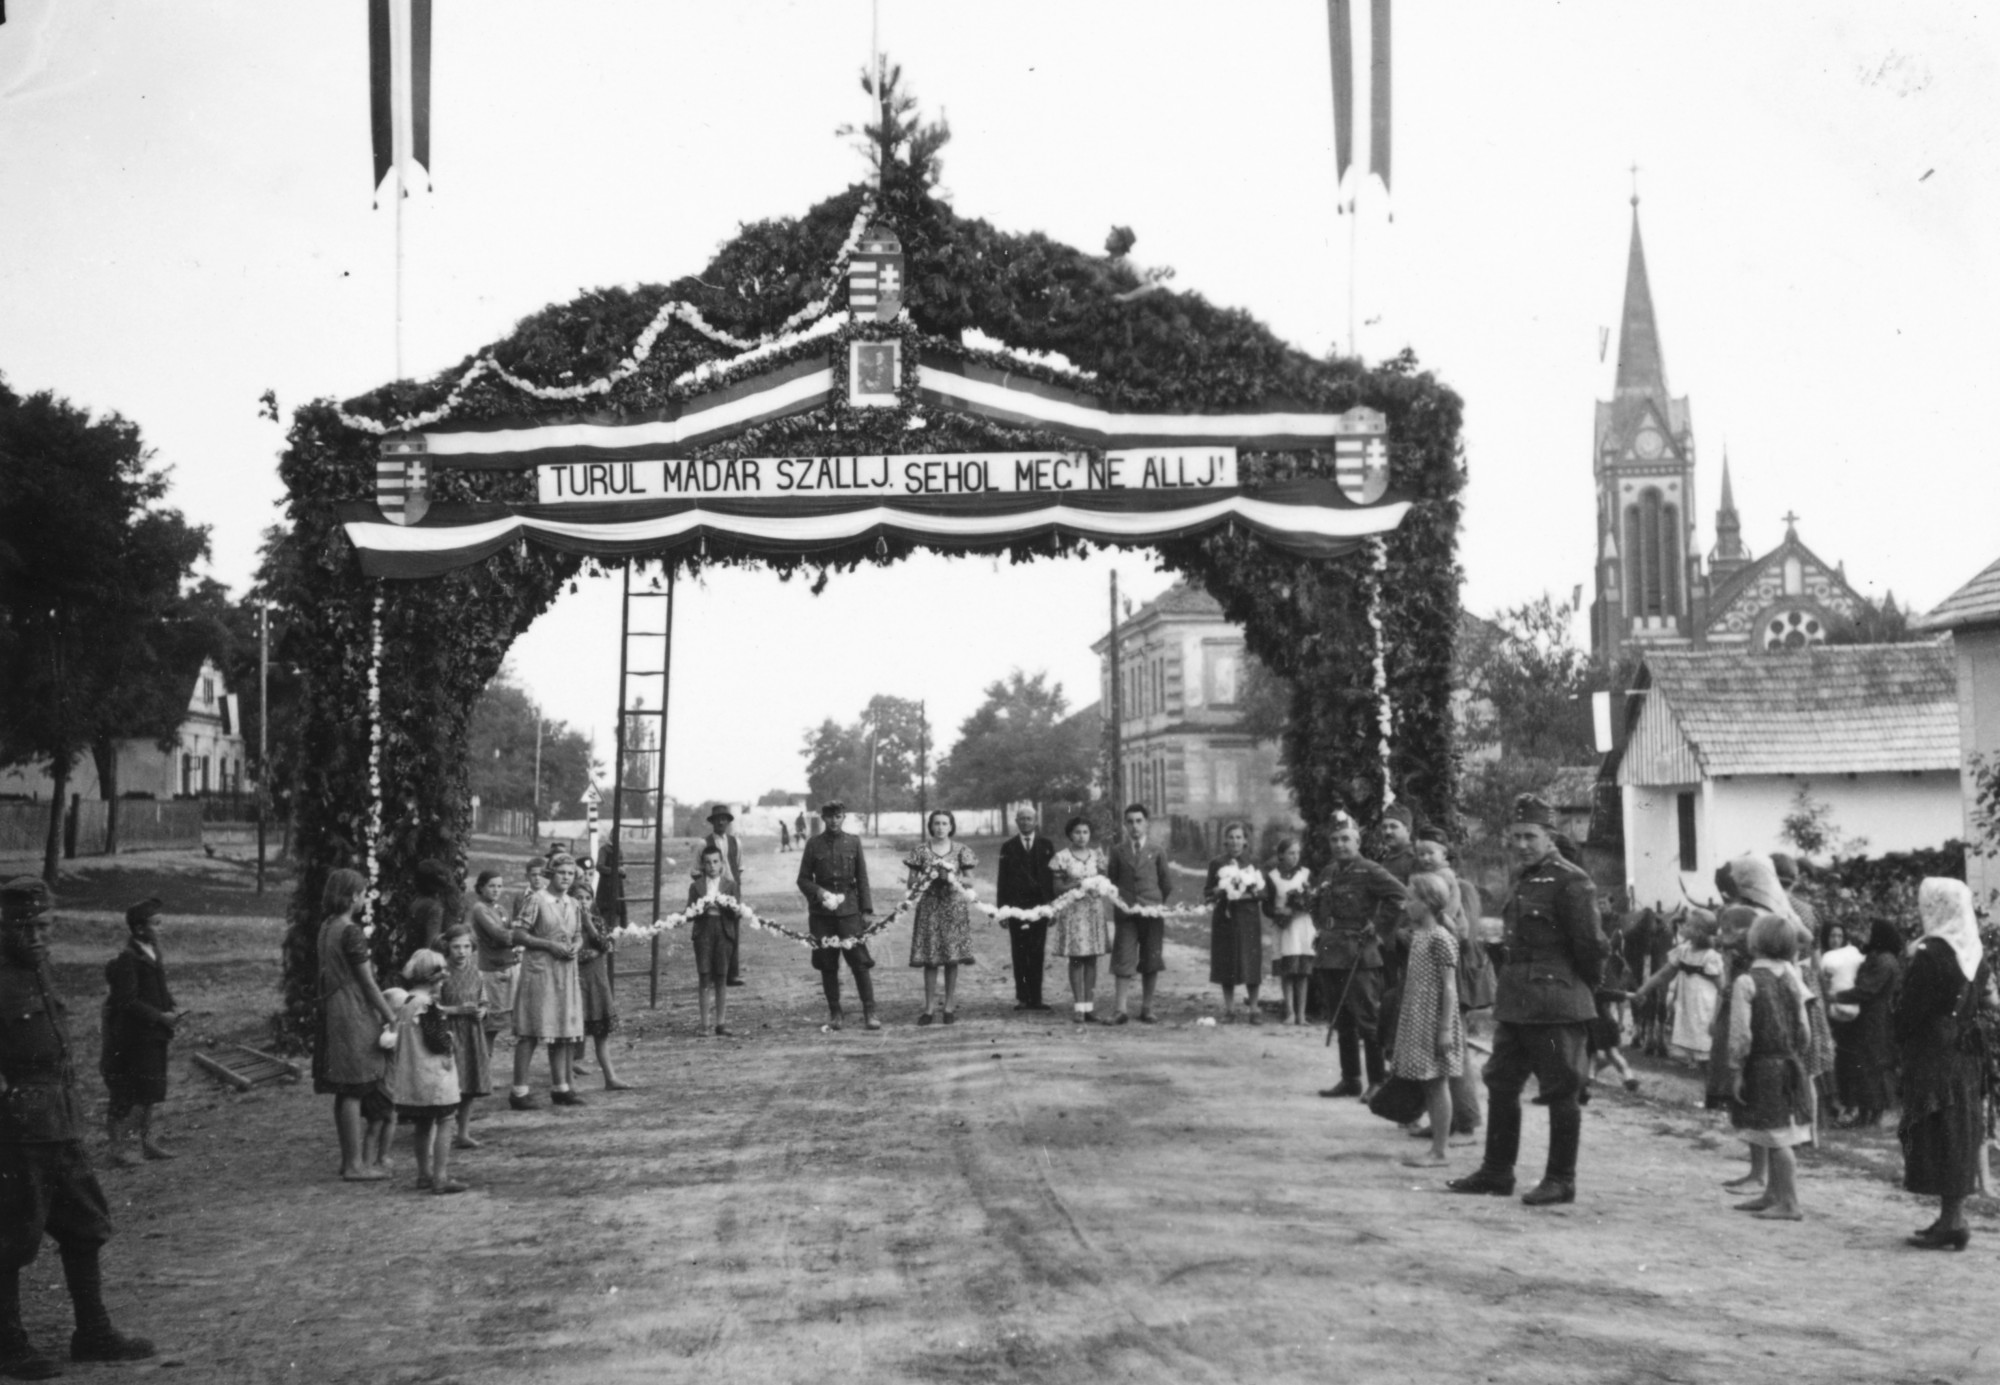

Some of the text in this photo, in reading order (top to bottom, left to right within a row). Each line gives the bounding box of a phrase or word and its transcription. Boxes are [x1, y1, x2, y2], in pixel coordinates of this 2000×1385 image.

[551, 463, 646, 497] TURUL
[904, 460, 1000, 494] SEHOL
[1088, 457, 1126, 490] NE
